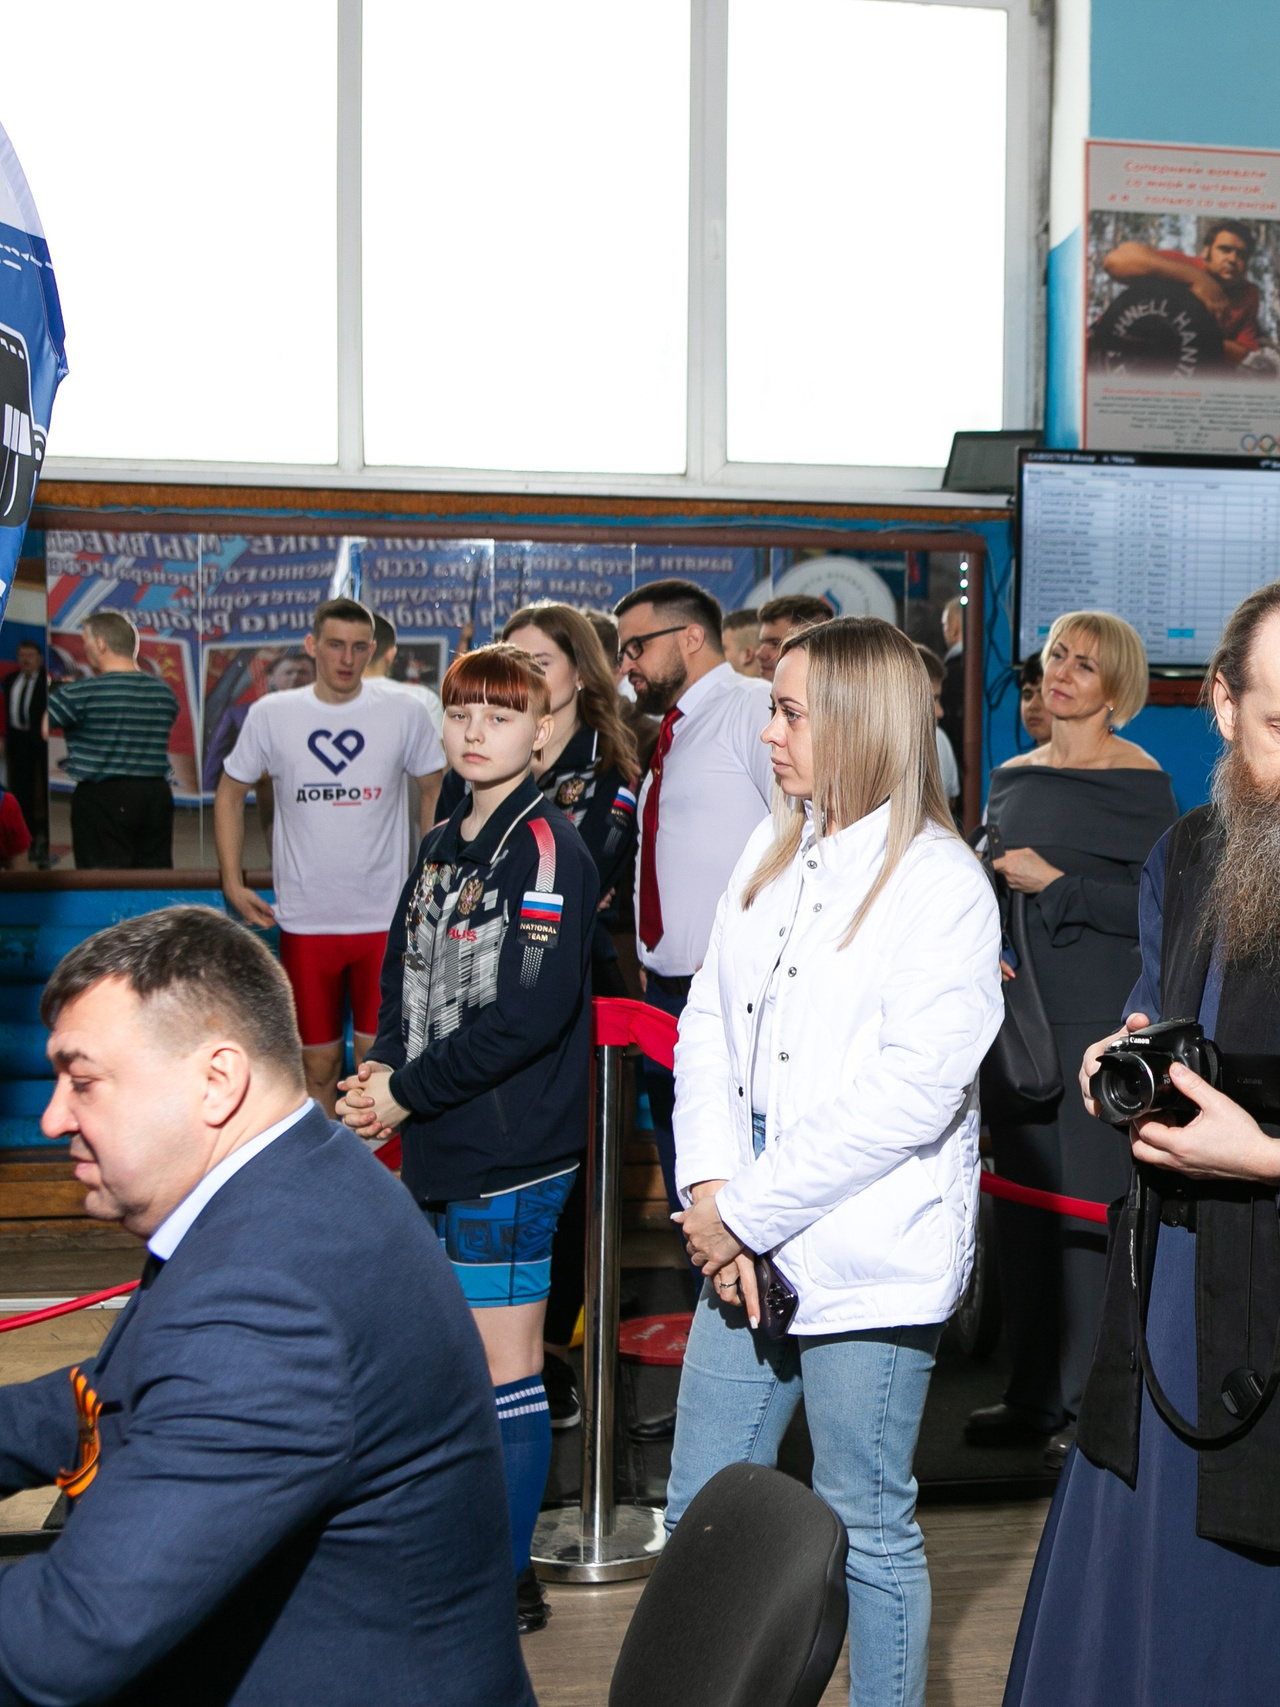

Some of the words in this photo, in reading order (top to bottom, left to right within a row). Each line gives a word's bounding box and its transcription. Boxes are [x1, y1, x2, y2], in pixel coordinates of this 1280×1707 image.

[1123, 159, 1203, 175] Соперники
[1207, 166, 1267, 179] воевали
[296, 786, 382, 804] ДОБРО57
[519, 922, 558, 935] NATIONAL
[527, 932, 549, 942] TEAM
[1129, 1035, 1151, 1044] Canon
[1236, 1075, 1263, 1086] Canon
